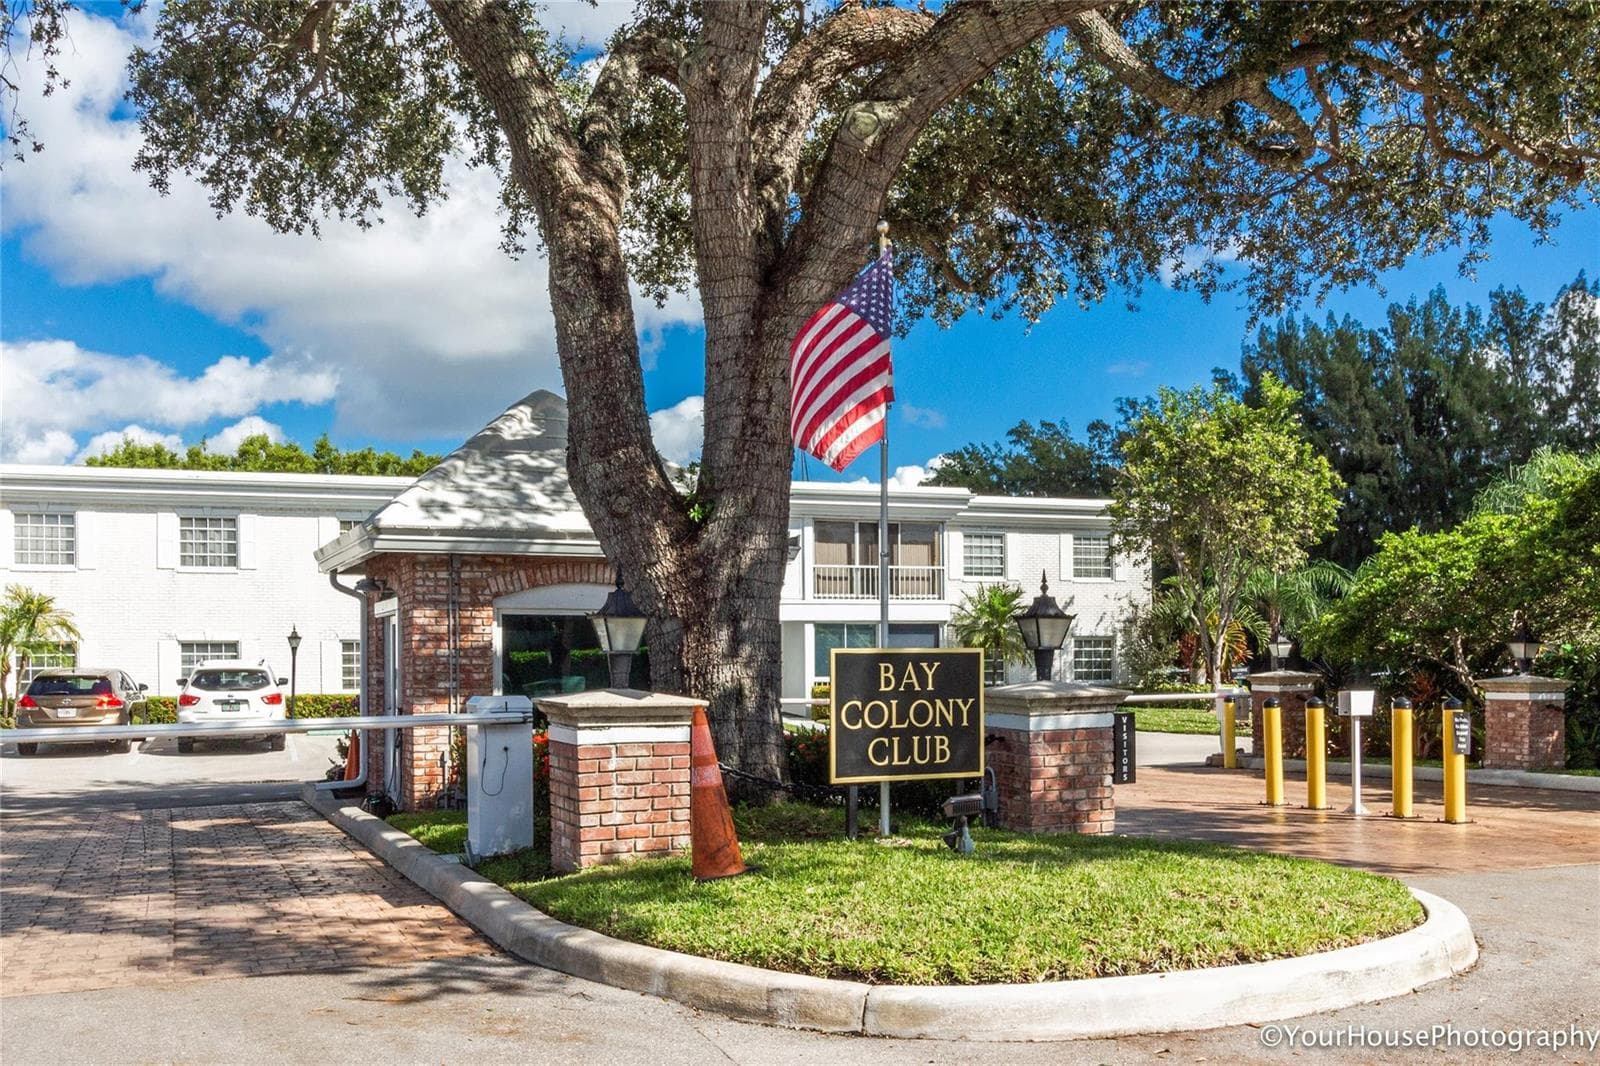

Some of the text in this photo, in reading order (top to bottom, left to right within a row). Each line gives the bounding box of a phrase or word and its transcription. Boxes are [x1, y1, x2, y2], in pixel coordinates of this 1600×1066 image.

[878, 661, 941, 692] BAY
[840, 698, 975, 730] COLONY
[867, 735, 951, 766] CLUB
